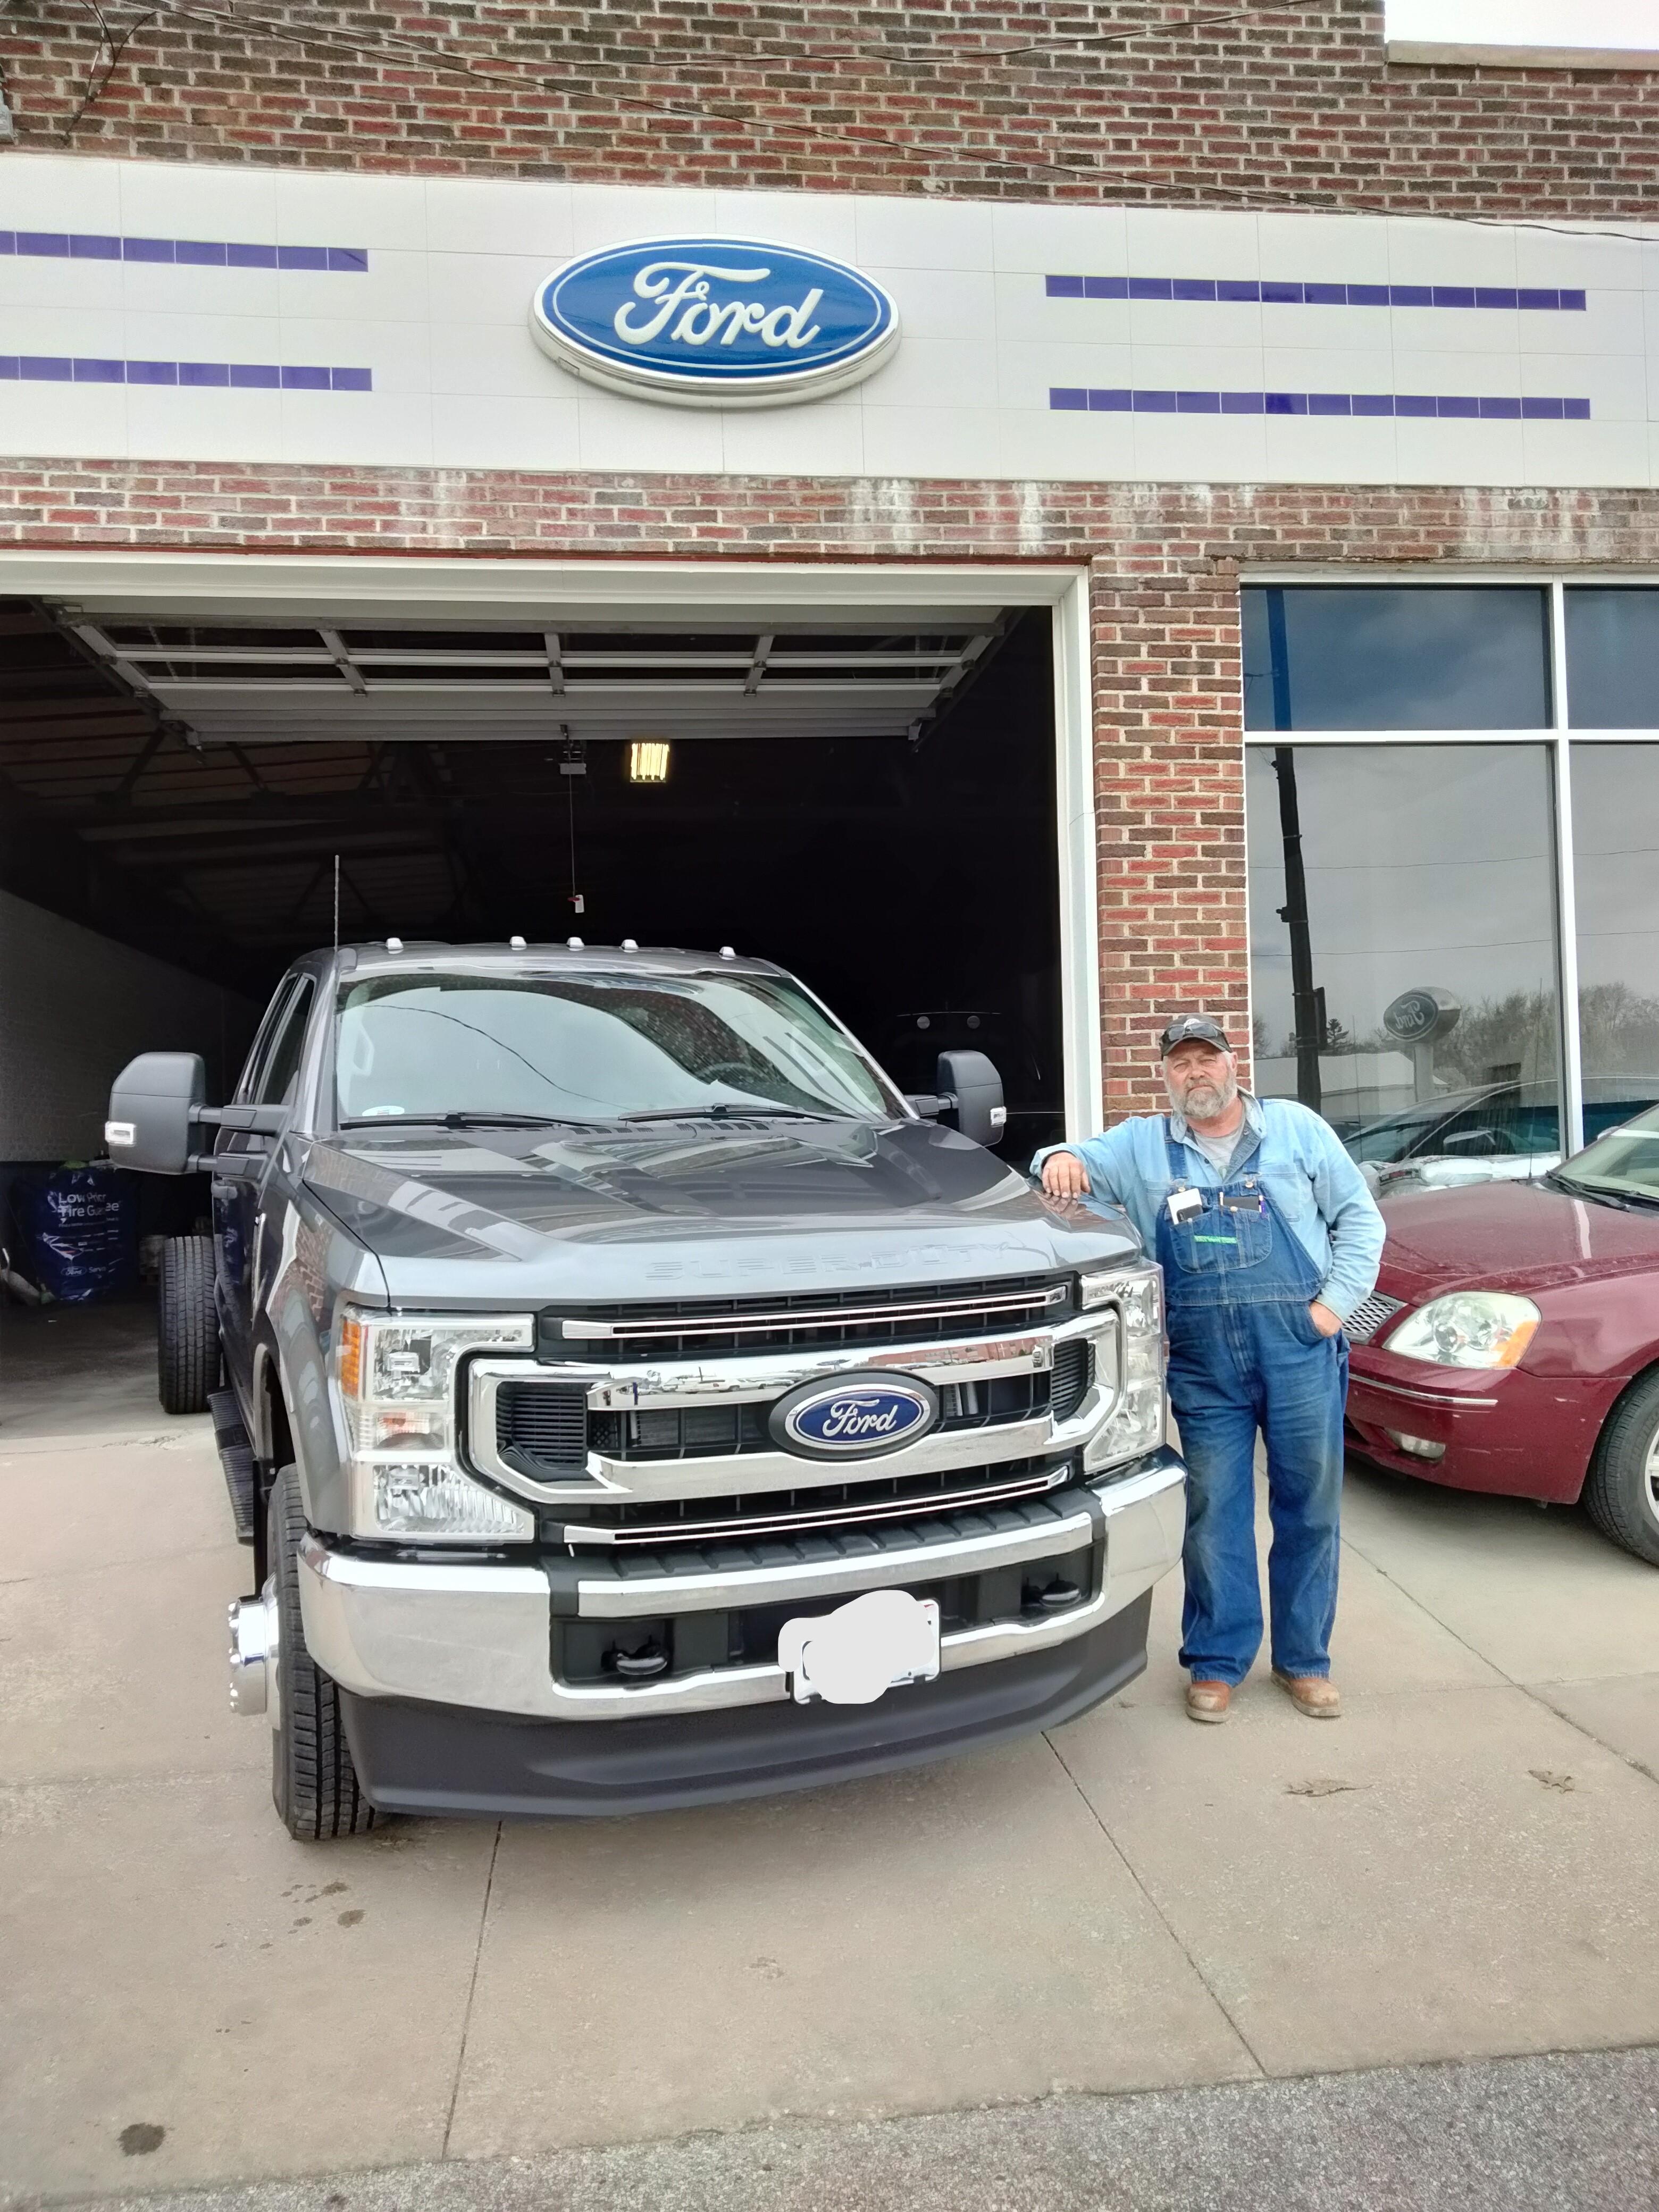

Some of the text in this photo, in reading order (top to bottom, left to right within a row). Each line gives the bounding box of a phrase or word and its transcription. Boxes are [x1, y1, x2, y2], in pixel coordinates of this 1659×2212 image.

[614, 262, 824, 349] Ford
[58, 1192, 86, 1203] Low
[58, 1205, 85, 1217] Tire
[645, 1242, 1010, 1281] SUPER DUTY
[822, 1398, 899, 1437] Ford
